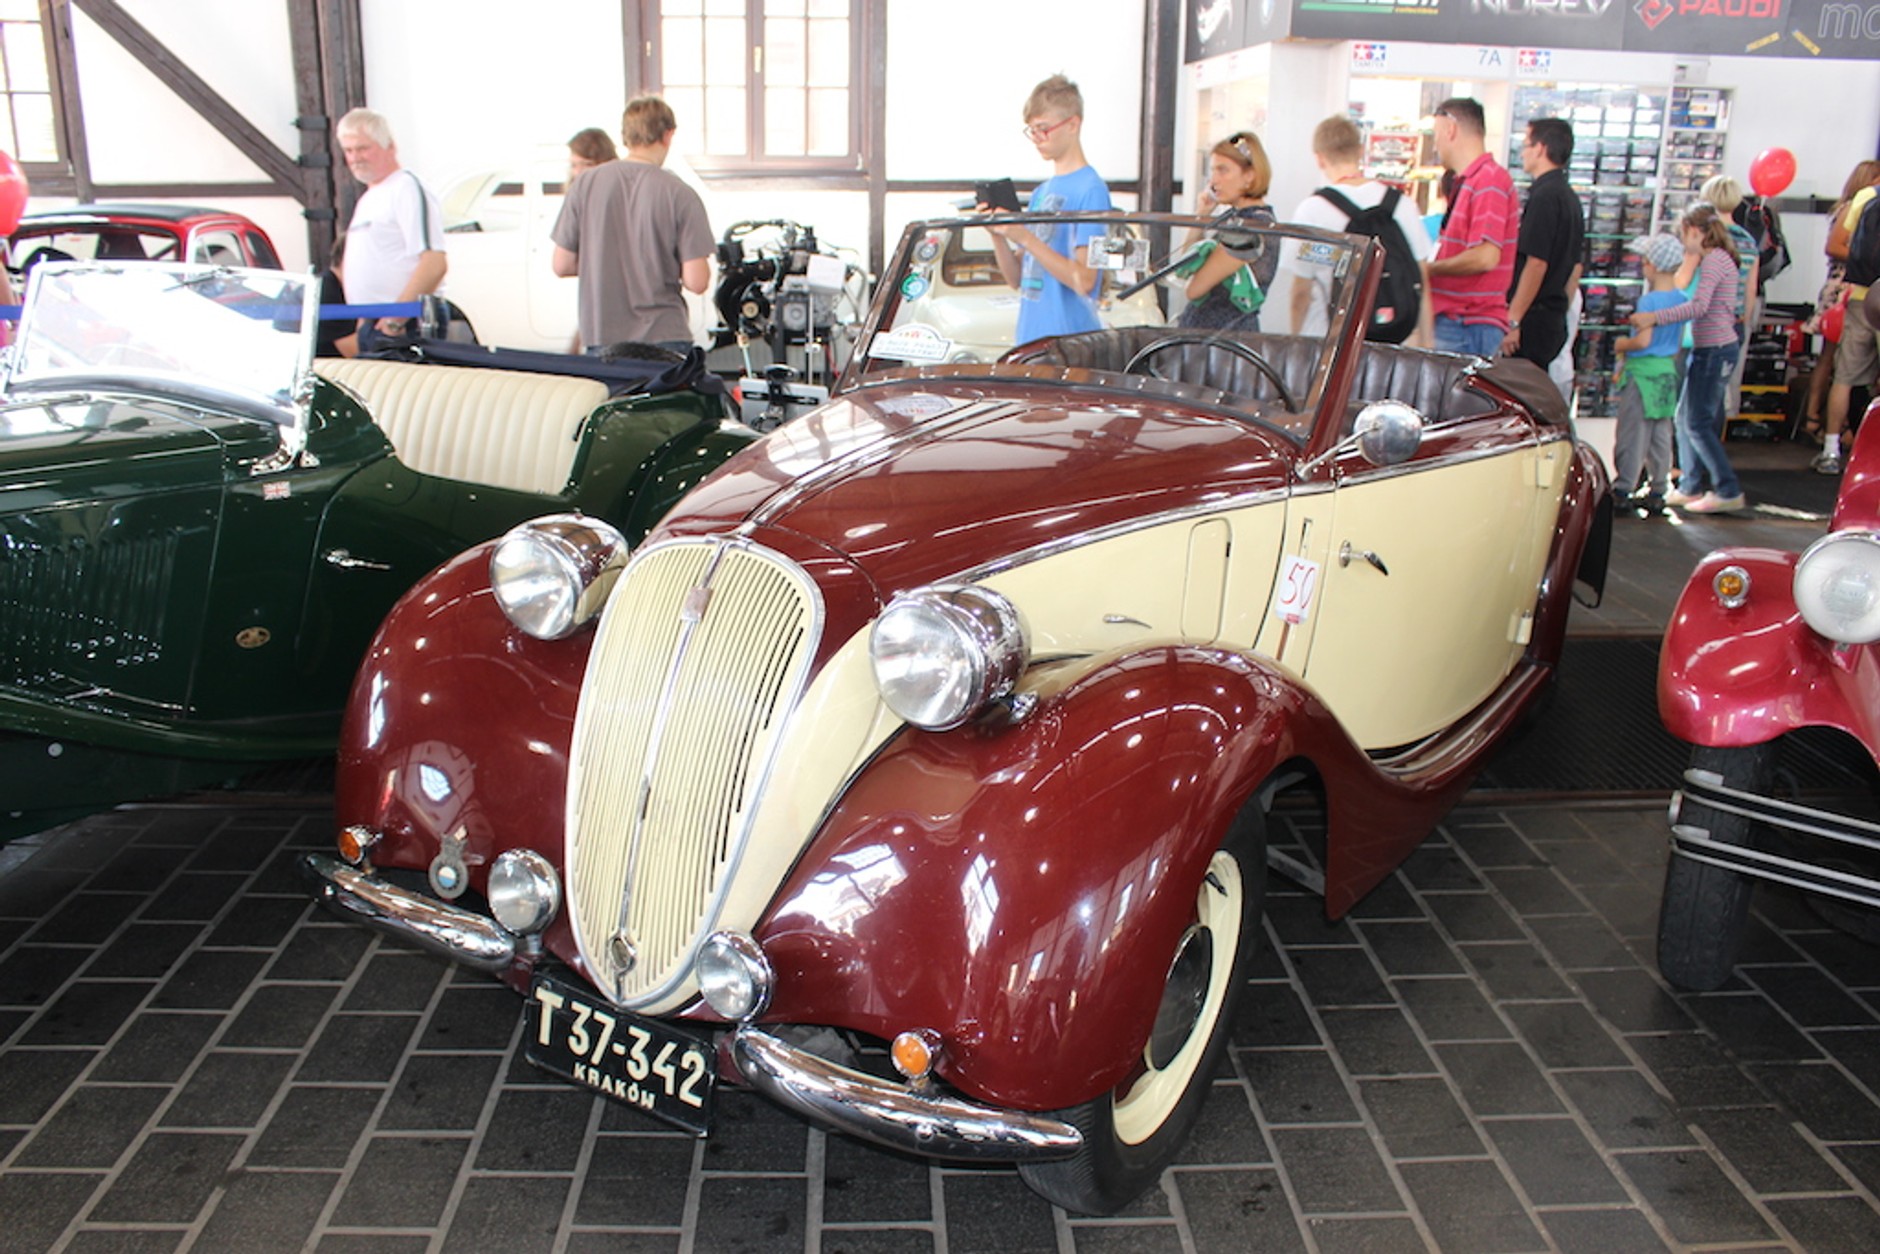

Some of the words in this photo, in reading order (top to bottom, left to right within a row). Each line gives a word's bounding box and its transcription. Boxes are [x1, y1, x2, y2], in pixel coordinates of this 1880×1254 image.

[1679, 0, 1780, 18] PAUDI
[1478, 49, 1502, 66] 7A
[1280, 562, 1315, 609] 50
[535, 986, 565, 1046] T
[567, 1001, 705, 1108] 37-342
[573, 1062, 656, 1110] KRAKÓW
